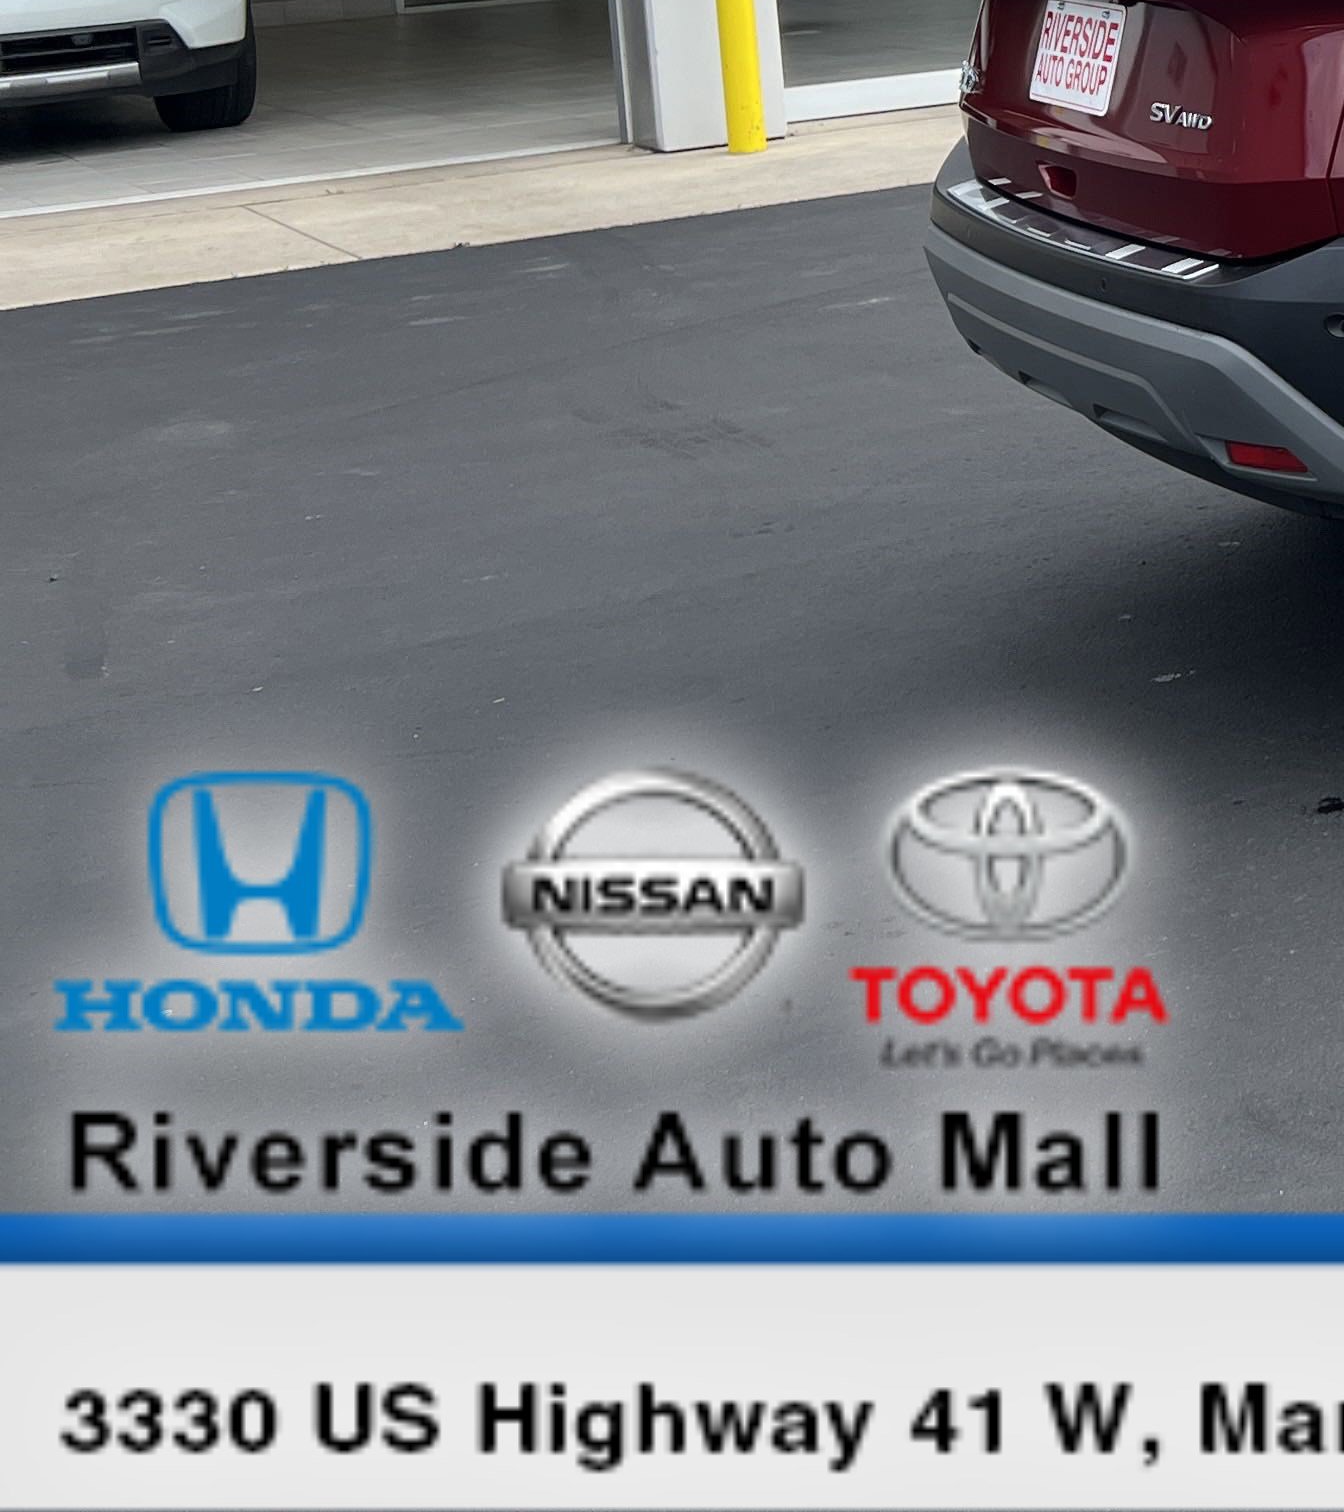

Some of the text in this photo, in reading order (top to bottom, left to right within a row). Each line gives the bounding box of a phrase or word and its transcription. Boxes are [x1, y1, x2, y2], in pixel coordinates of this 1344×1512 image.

[1039, 10, 1120, 63] RIVERSIDE
[1034, 55, 1109, 96] AUTO GROUP
